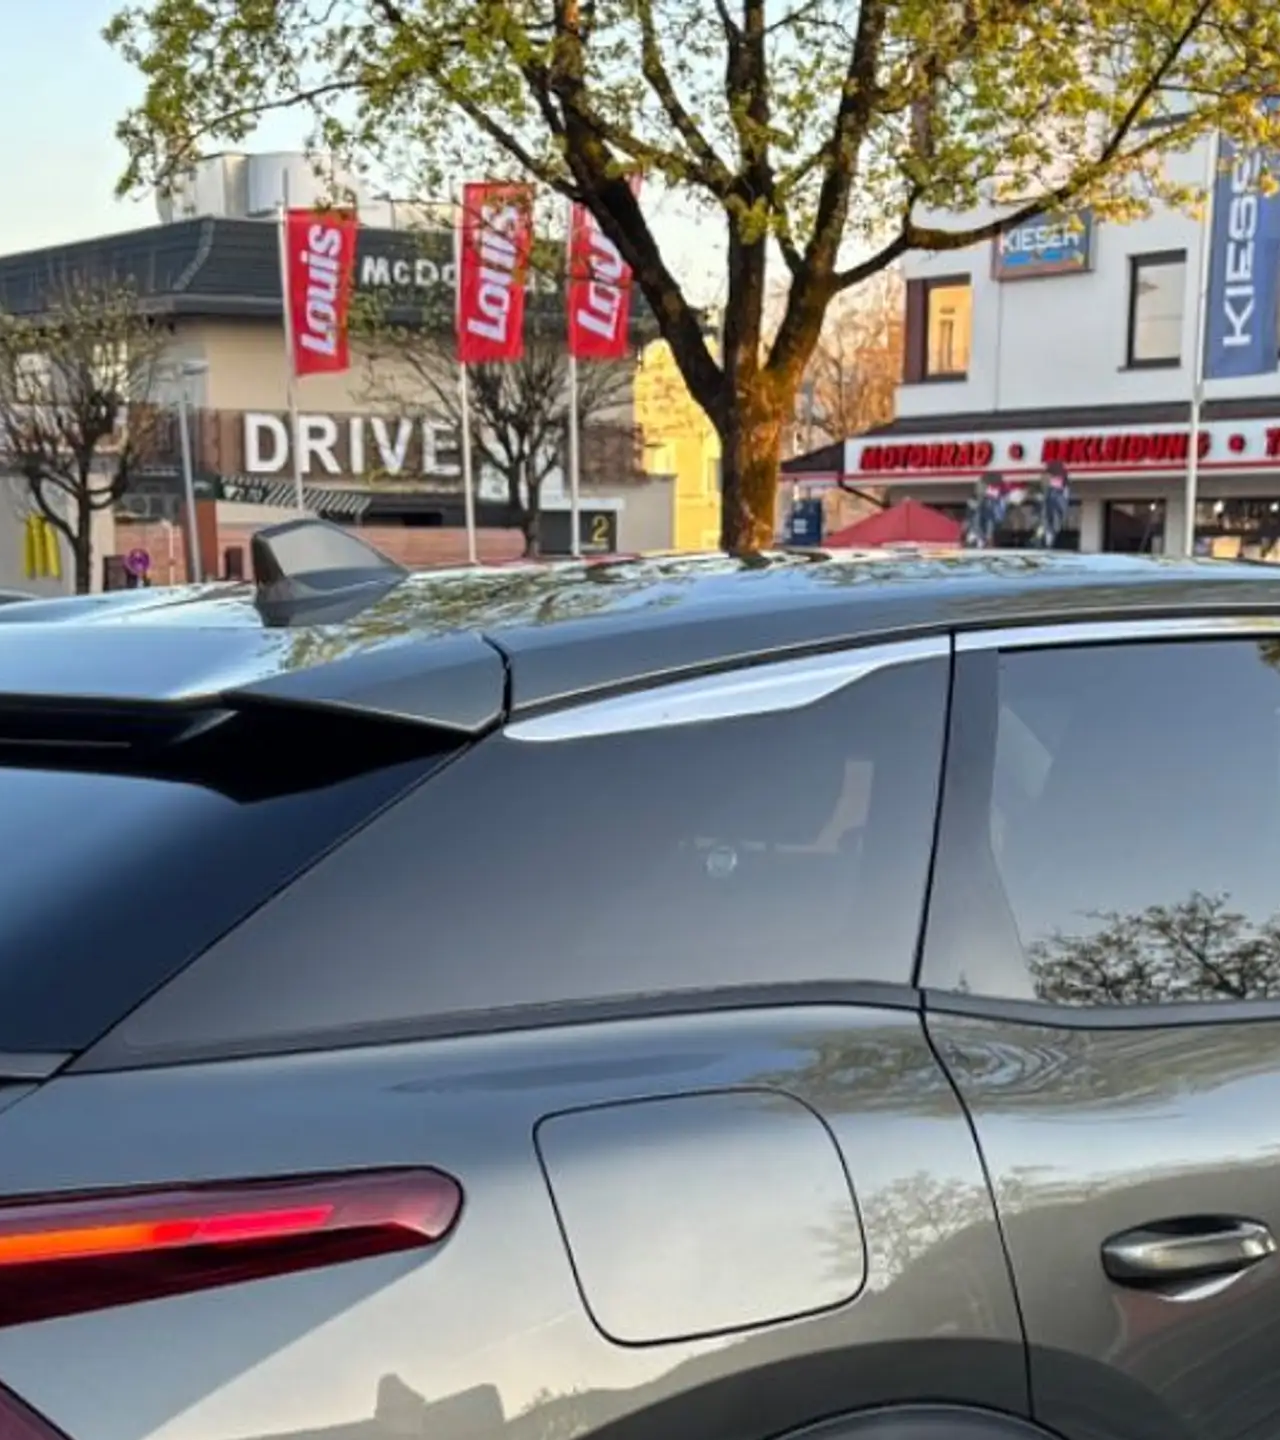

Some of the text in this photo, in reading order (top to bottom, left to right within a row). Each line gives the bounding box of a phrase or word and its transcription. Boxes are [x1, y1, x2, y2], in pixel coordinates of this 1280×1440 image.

[300, 223, 342, 357] Louis
[467, 205, 517, 343] Louis
[577, 232, 622, 341] Lou
[244, 412, 462, 477] DRIVE
[859, 440, 994, 470] MOTORRAD
[592, 514, 610, 543] 2
